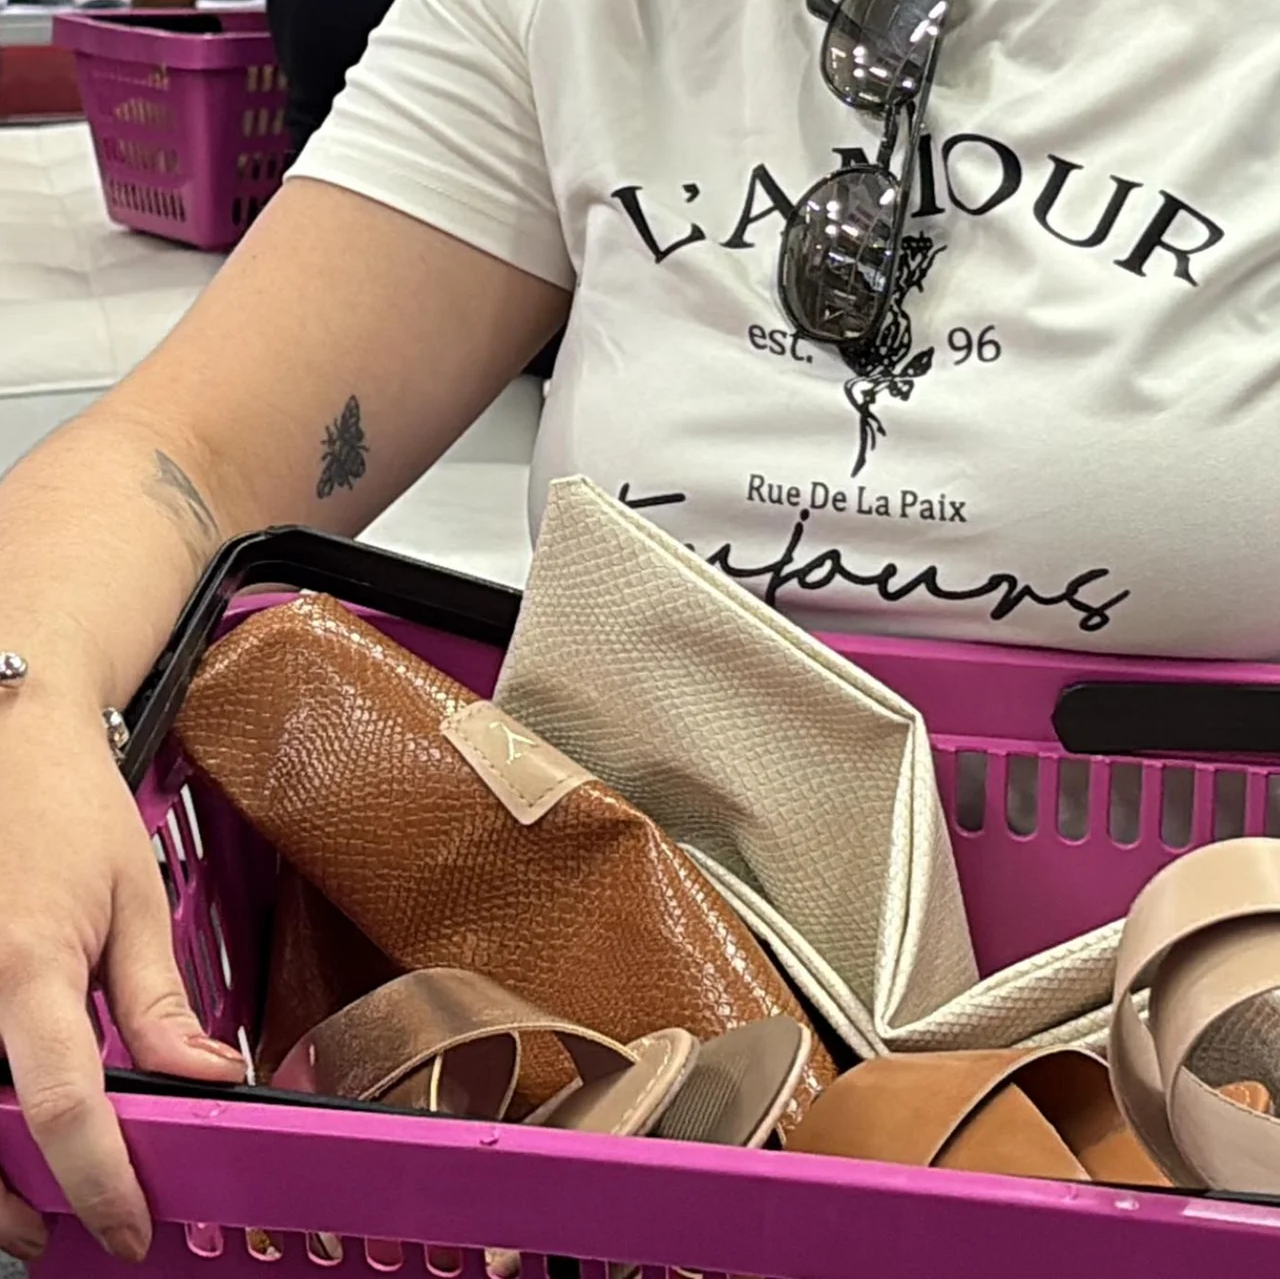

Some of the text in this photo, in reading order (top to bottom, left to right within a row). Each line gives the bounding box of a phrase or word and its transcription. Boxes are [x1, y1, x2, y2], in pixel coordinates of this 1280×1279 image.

[748, 323, 1003, 366] est. 96
[747, 474, 968, 524] Rue De La Paix
